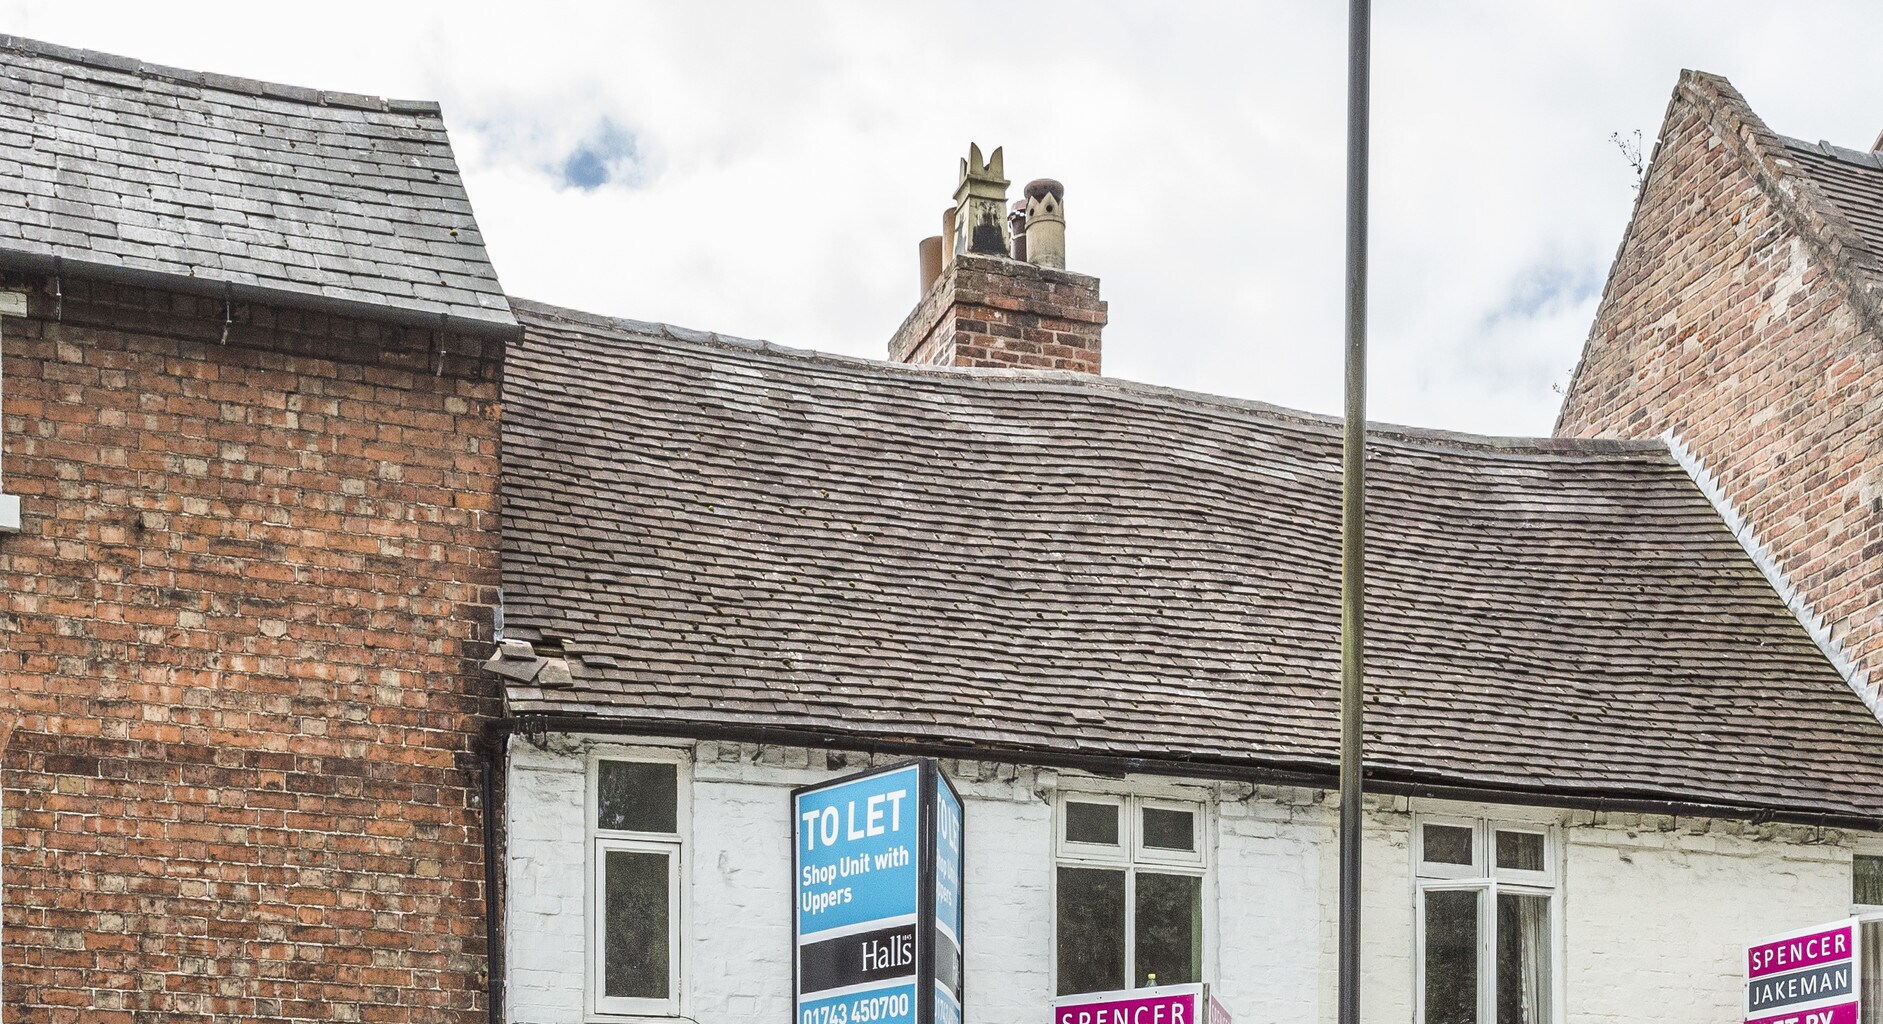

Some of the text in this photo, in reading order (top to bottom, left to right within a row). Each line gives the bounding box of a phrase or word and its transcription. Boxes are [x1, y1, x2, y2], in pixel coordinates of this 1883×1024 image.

[803, 789, 906, 850] TO LET
[803, 845, 909, 887] Shop Unit with
[802, 885, 852, 915] Uppers
[862, 935, 912, 971] Halls
[1752, 933, 1846, 971] SPENCER
[1753, 969, 1847, 1005] JAKEMAN
[851, 993, 908, 1023] 450700
